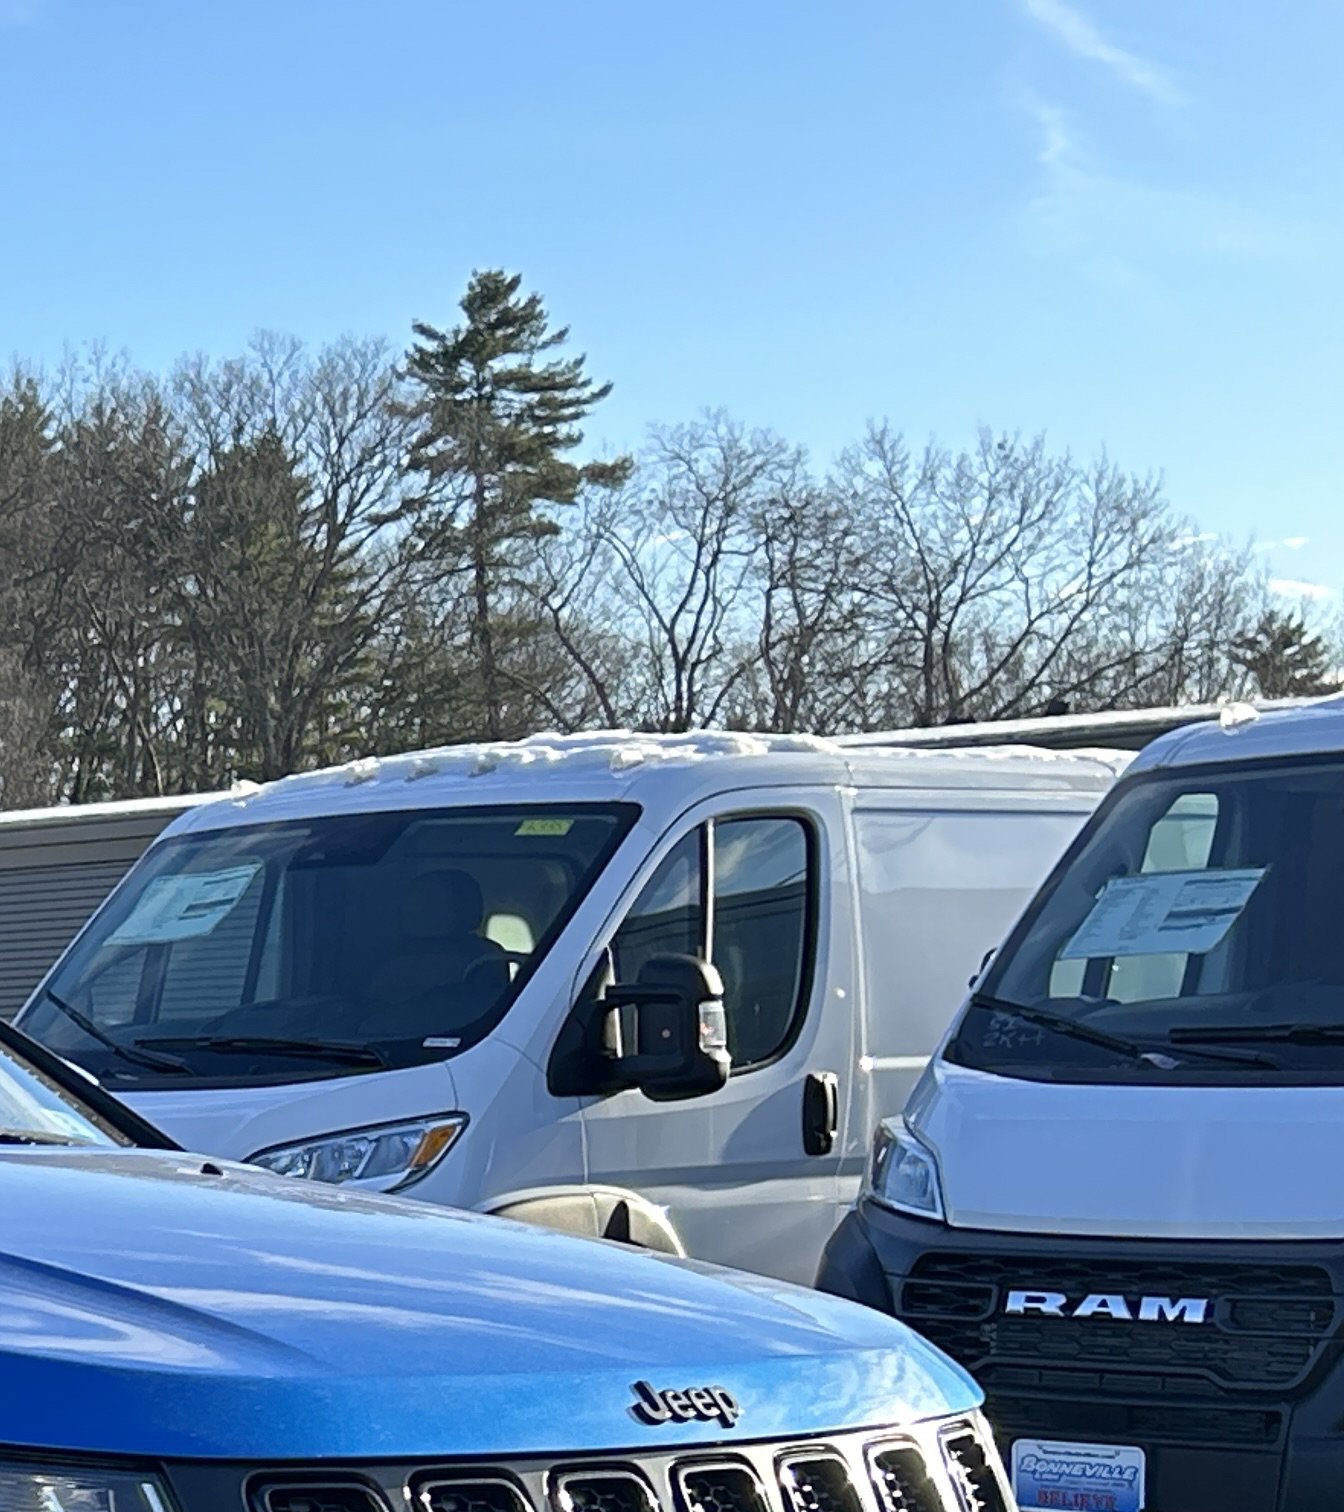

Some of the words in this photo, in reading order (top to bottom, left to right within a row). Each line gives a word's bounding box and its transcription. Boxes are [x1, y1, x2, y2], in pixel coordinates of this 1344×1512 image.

[1005, 1290, 1209, 1324] RAM
[625, 1380, 740, 1429] Jeep
[1019, 1454, 1139, 1482] BONNEVILLE
